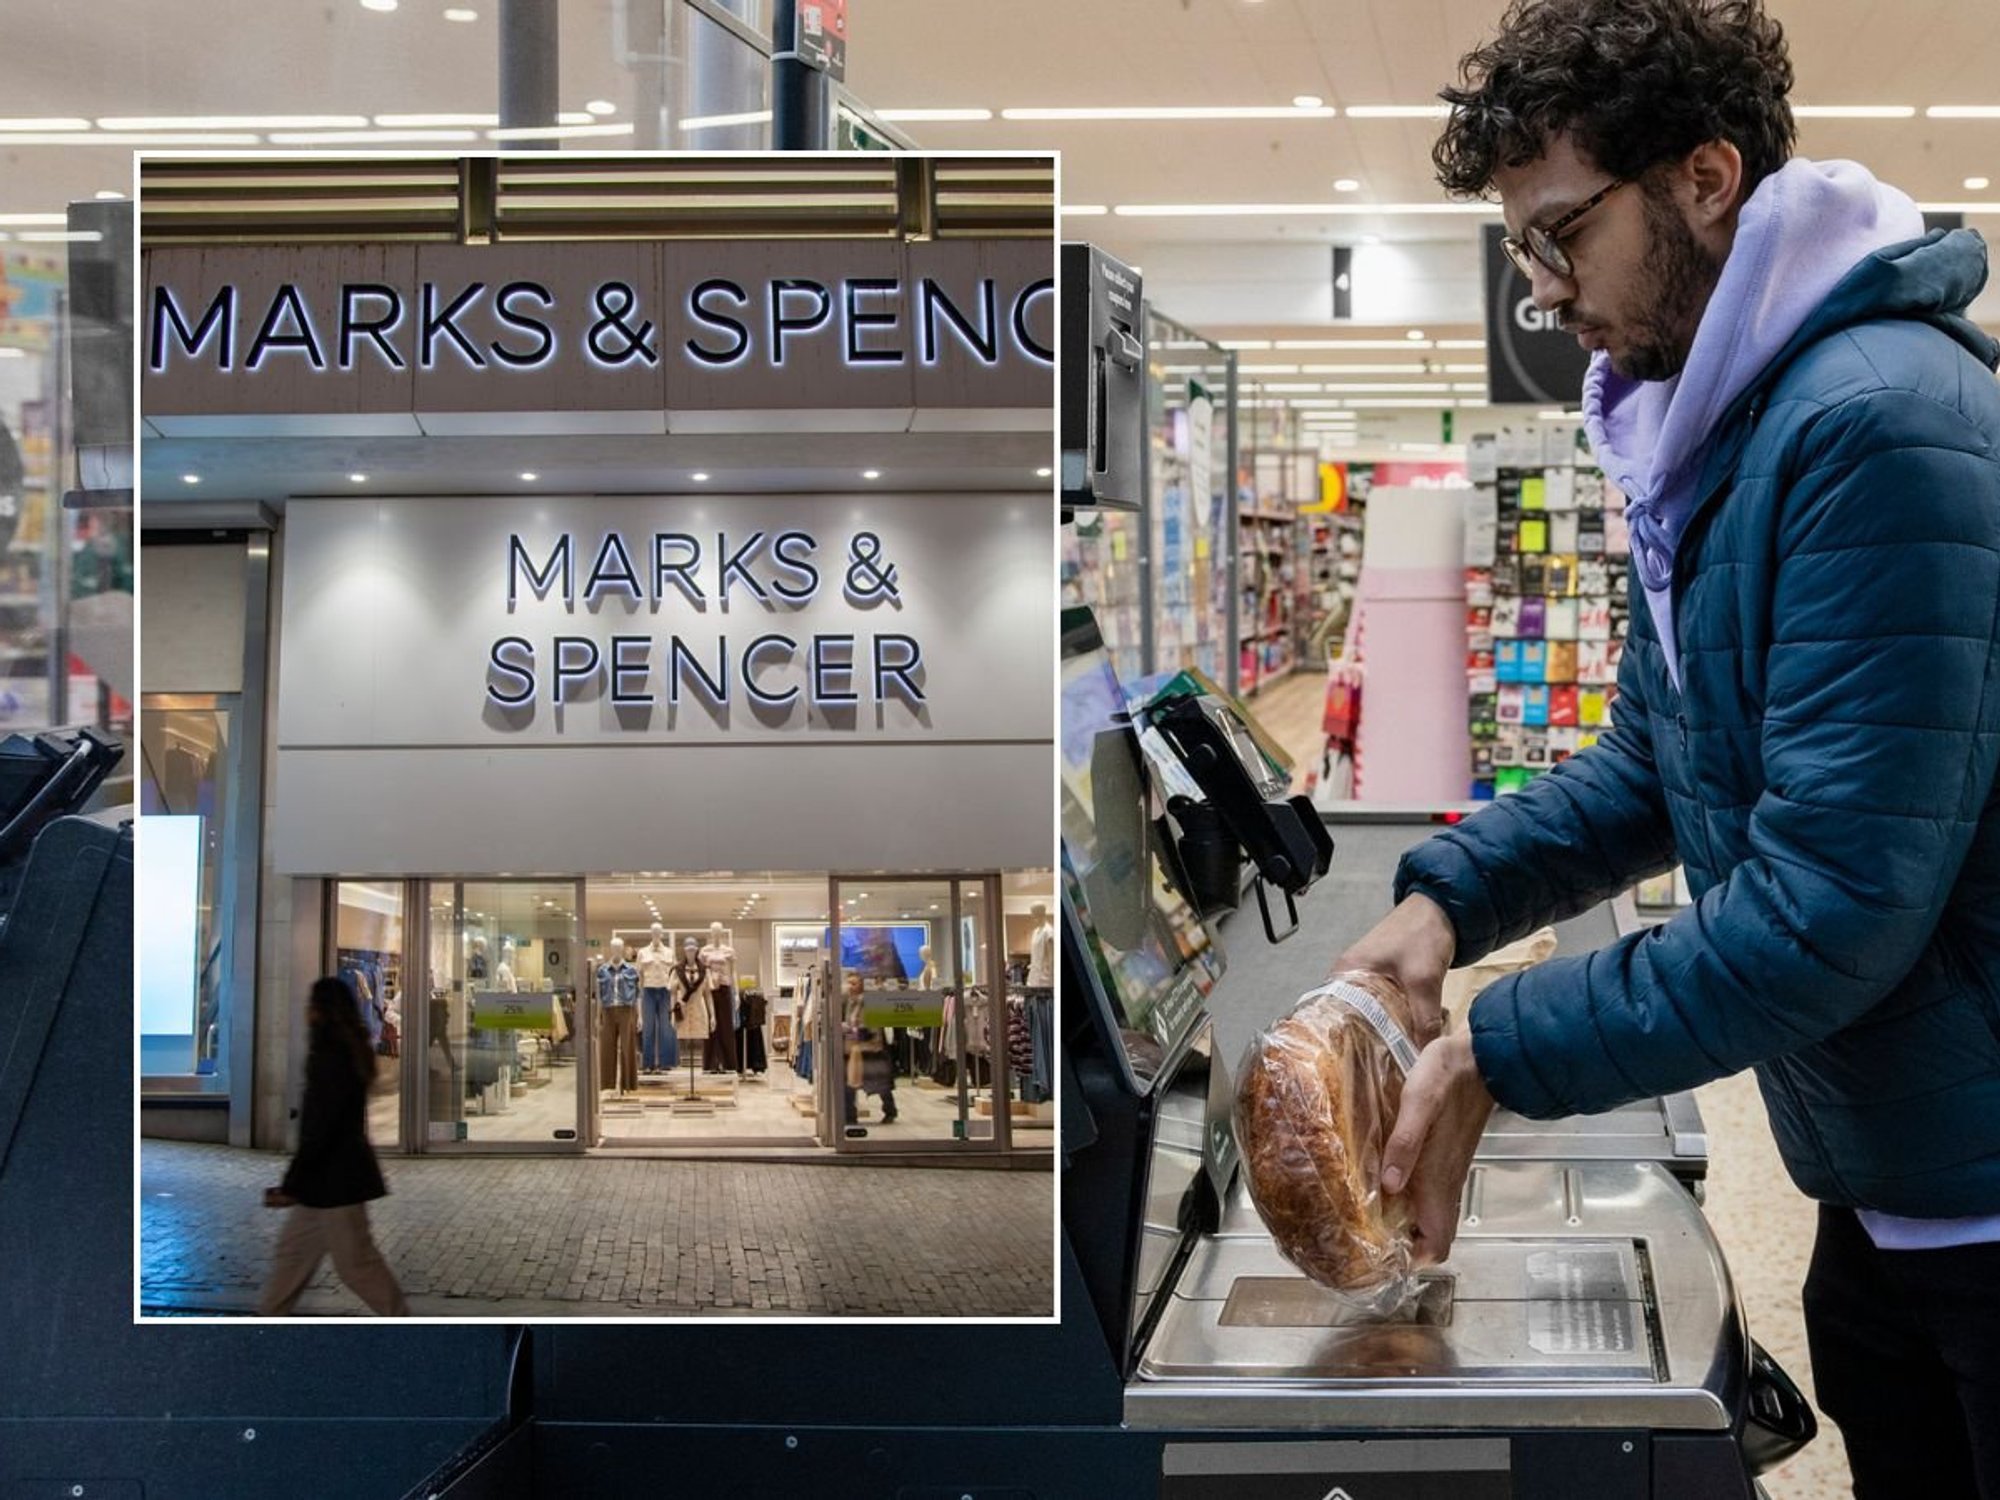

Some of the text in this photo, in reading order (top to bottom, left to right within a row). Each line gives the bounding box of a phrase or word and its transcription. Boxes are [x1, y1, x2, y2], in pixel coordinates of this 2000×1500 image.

[149, 282, 554, 368] MARKS
[588, 281, 657, 366] &
[509, 532, 899, 599] MARKS &
[488, 636, 926, 703] SPENCER
